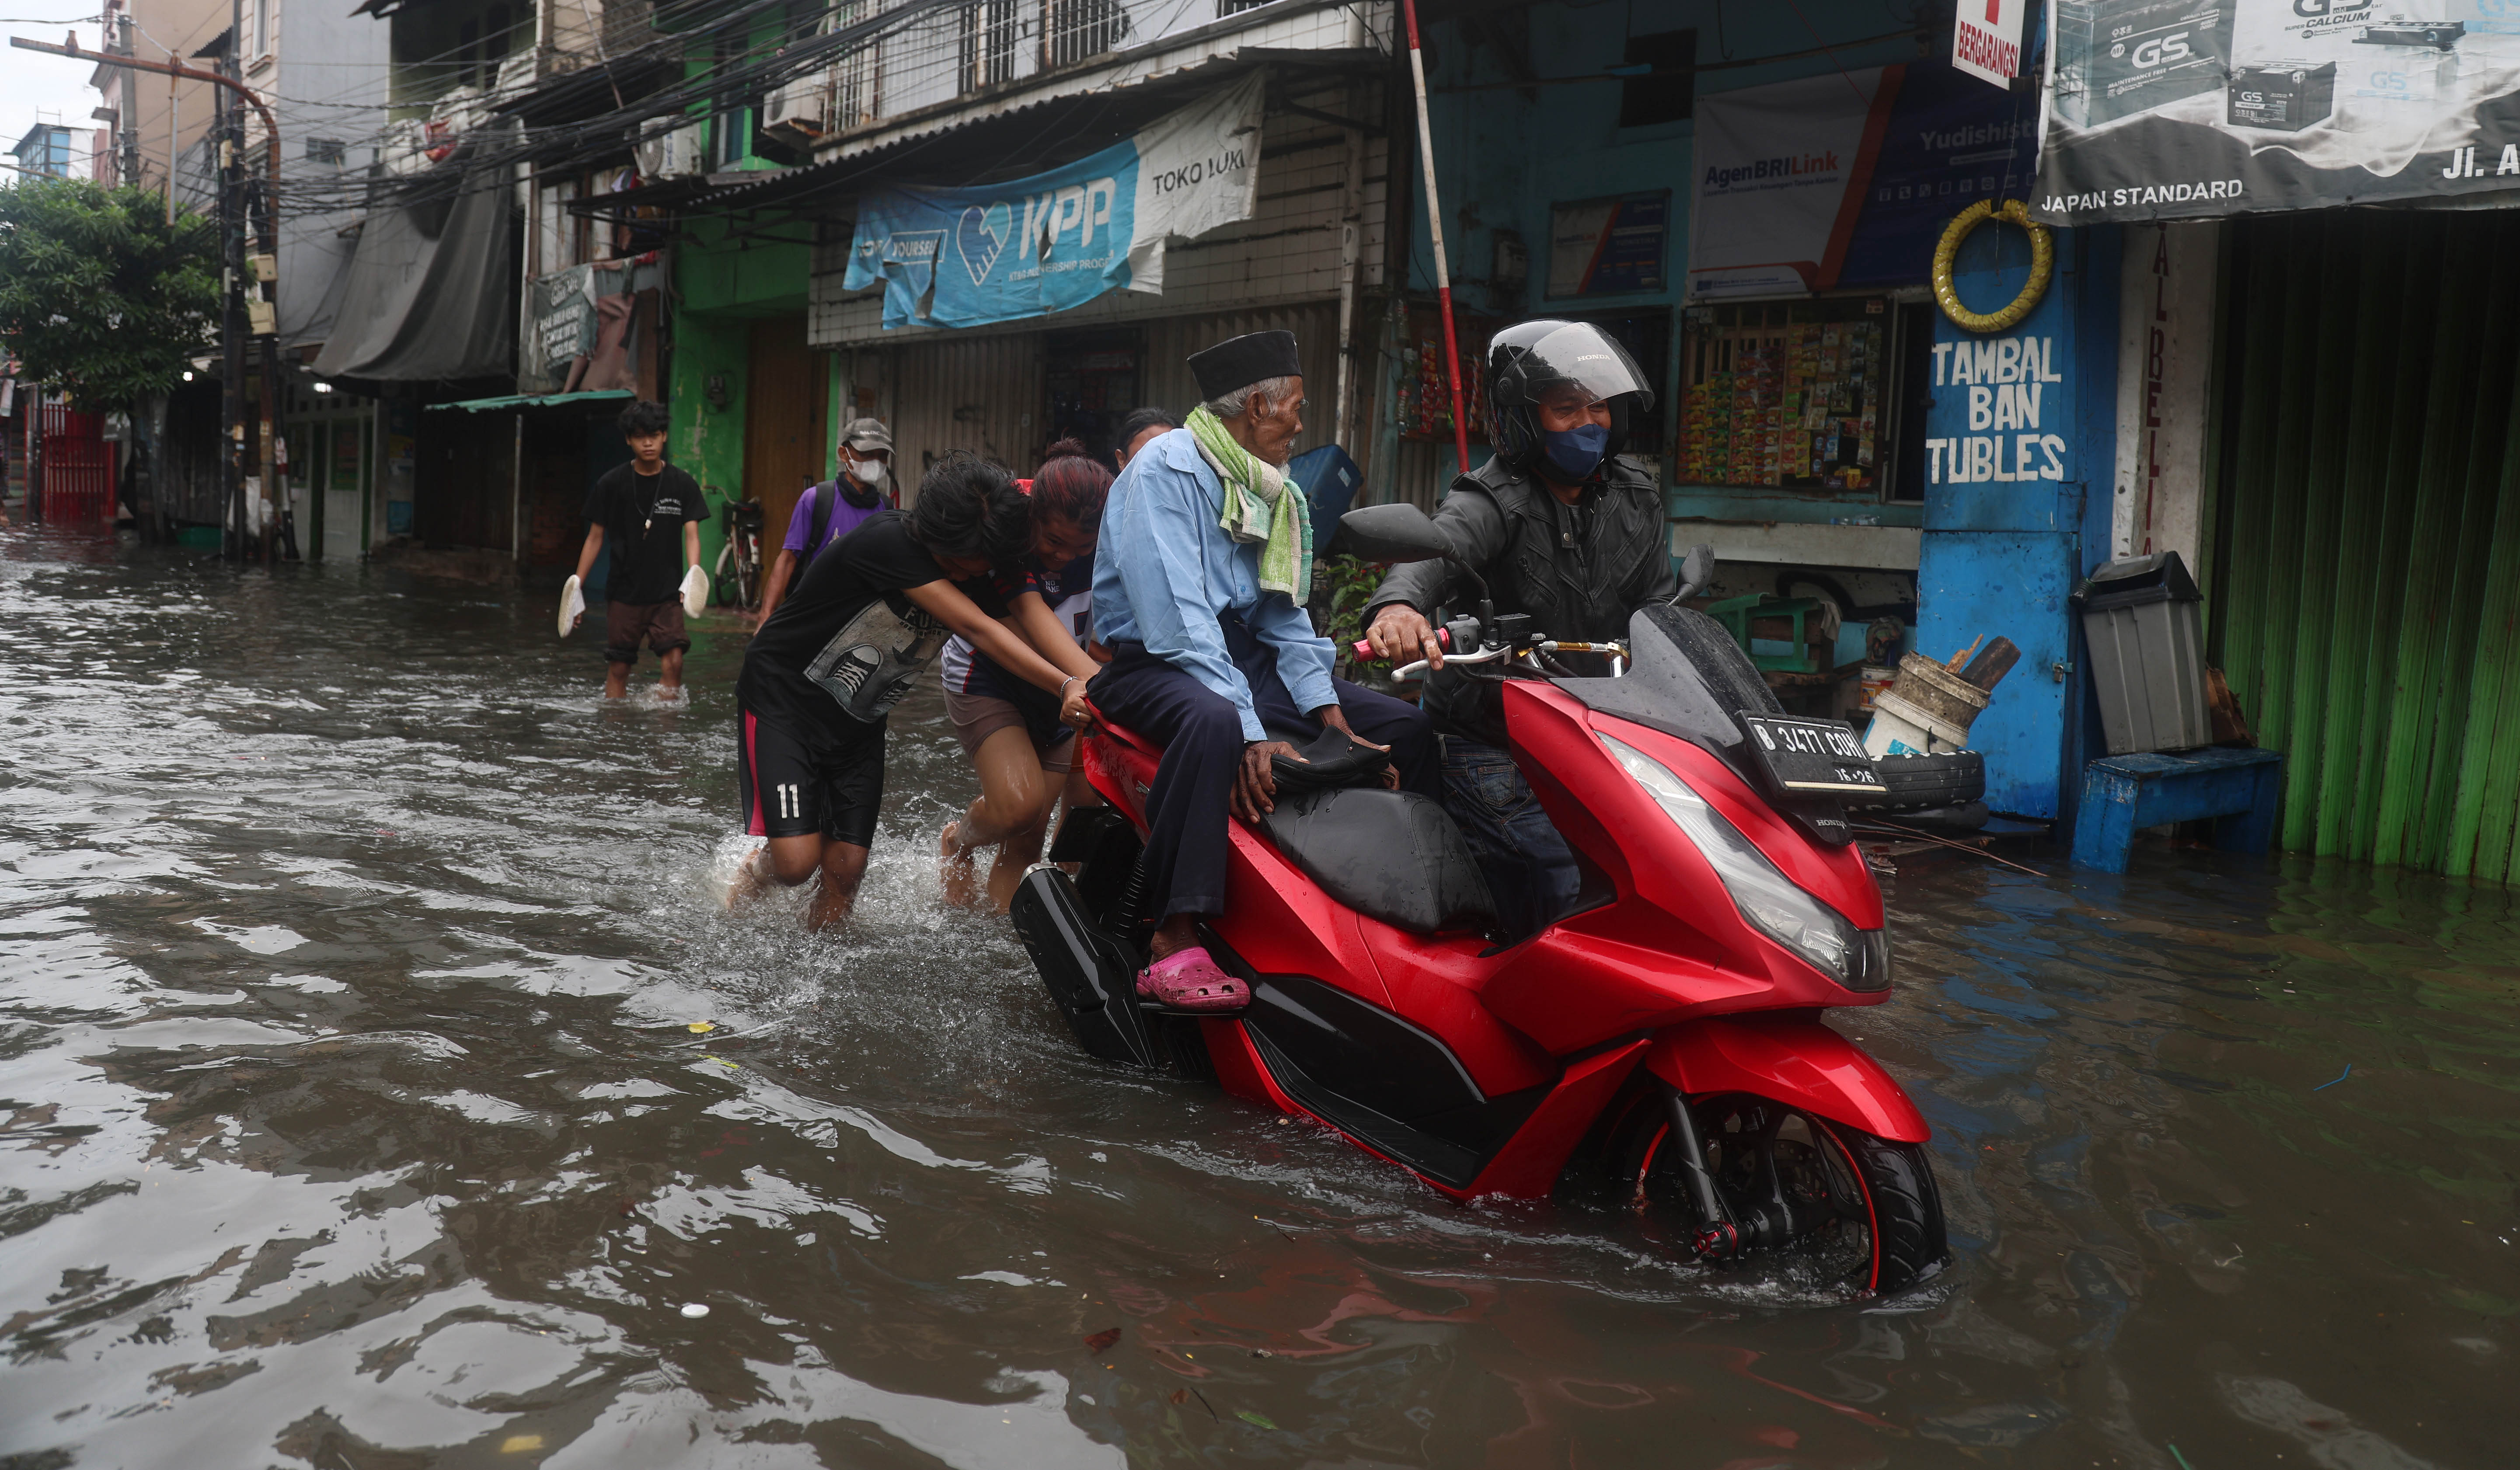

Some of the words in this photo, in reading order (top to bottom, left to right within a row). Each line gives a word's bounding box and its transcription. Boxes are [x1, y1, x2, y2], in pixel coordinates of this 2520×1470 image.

[2306, 12, 2371, 28] CALCIUM
[1958, 21, 2018, 78] BERGARANGSI
[2132, 31, 2189, 69] GS
[2108, 71, 2151, 89] MAINTENANCE
[2153, 68, 2167, 76] FREE
[2370, 70, 2407, 90] GS
[2241, 91, 2262, 102] GS
[1153, 162, 1202, 195] TOKO
[1705, 150, 1839, 188] AgenBRILink
[2041, 190, 2106, 213] JAPAN
[2112, 179, 2244, 206] STANDARD
[1019, 177, 1116, 261] KPP
[1931, 336, 2062, 387] TAMBAL
[1969, 382, 2042, 432] BAN
[1925, 434, 2066, 484] TUBLES
[1753, 724, 1776, 751] B
[1778, 727, 1826, 754] 3477
[777, 783, 800, 819] 11
[1816, 819, 1847, 829] HONDA
